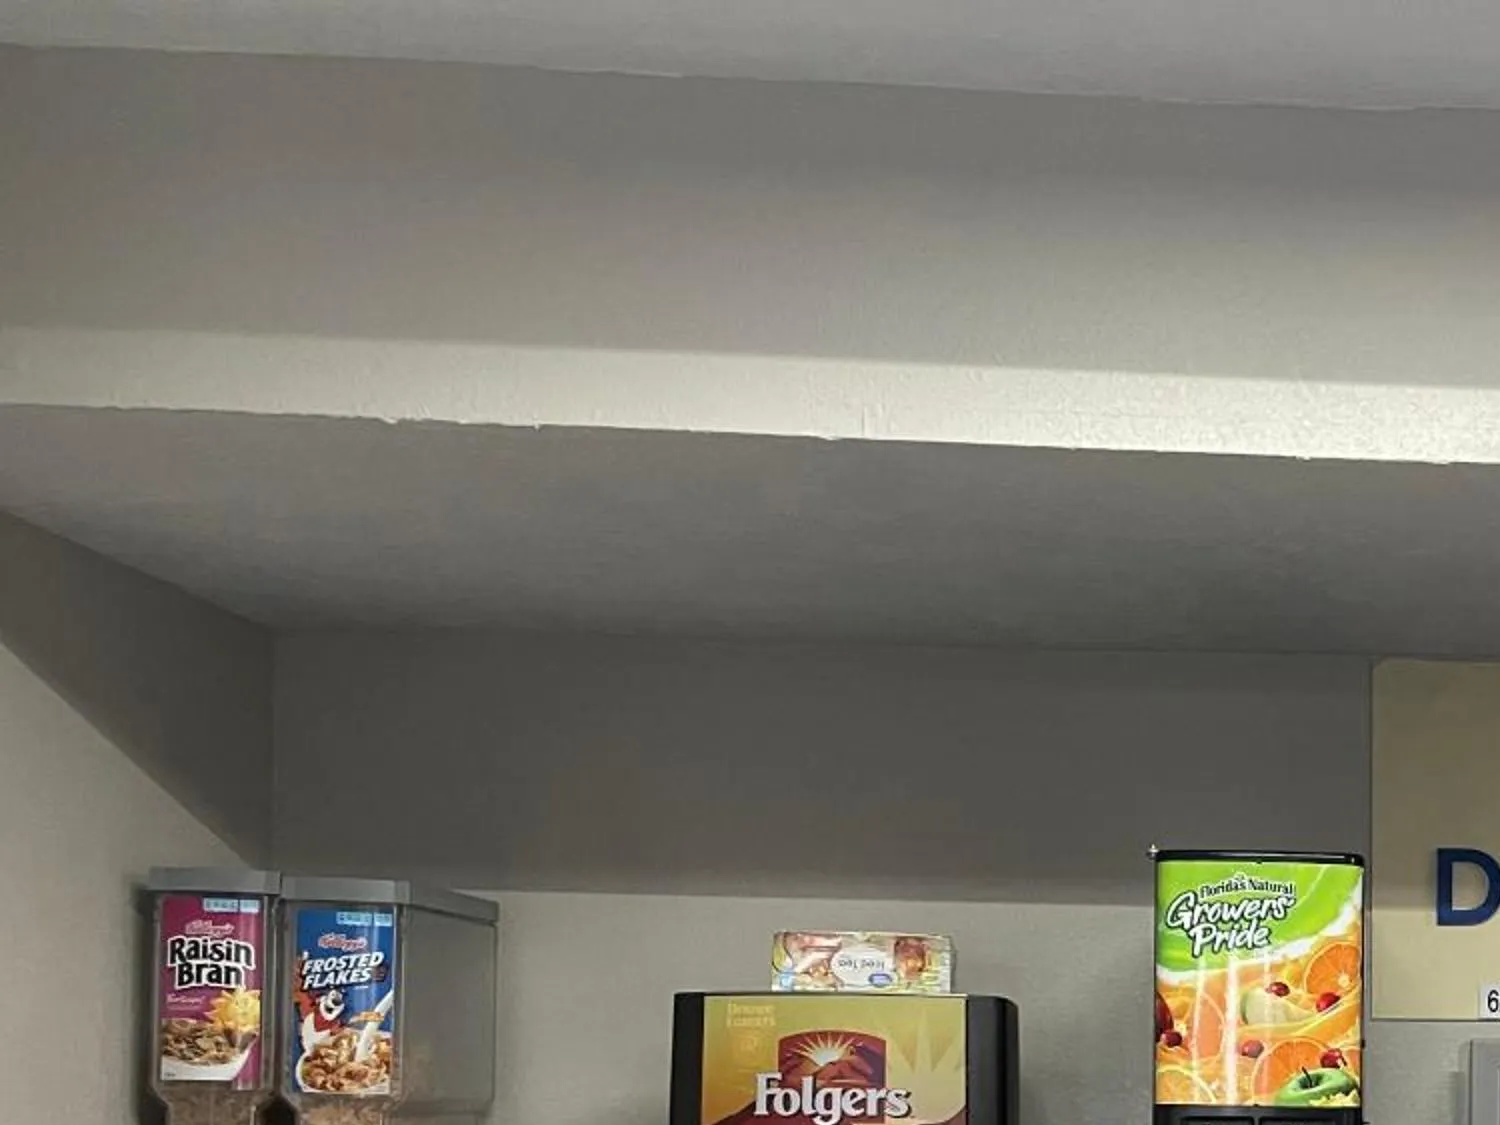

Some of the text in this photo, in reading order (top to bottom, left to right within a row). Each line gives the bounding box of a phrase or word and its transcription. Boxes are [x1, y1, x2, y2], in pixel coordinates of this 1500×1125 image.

[1249, 878, 1294, 896] Natural
[1188, 918, 1271, 958] Pride
[168, 936, 255, 969] Raisin
[302, 952, 384, 976] FROSTED
[175, 961, 246, 990] Bran
[303, 968, 373, 990] FLAKES
